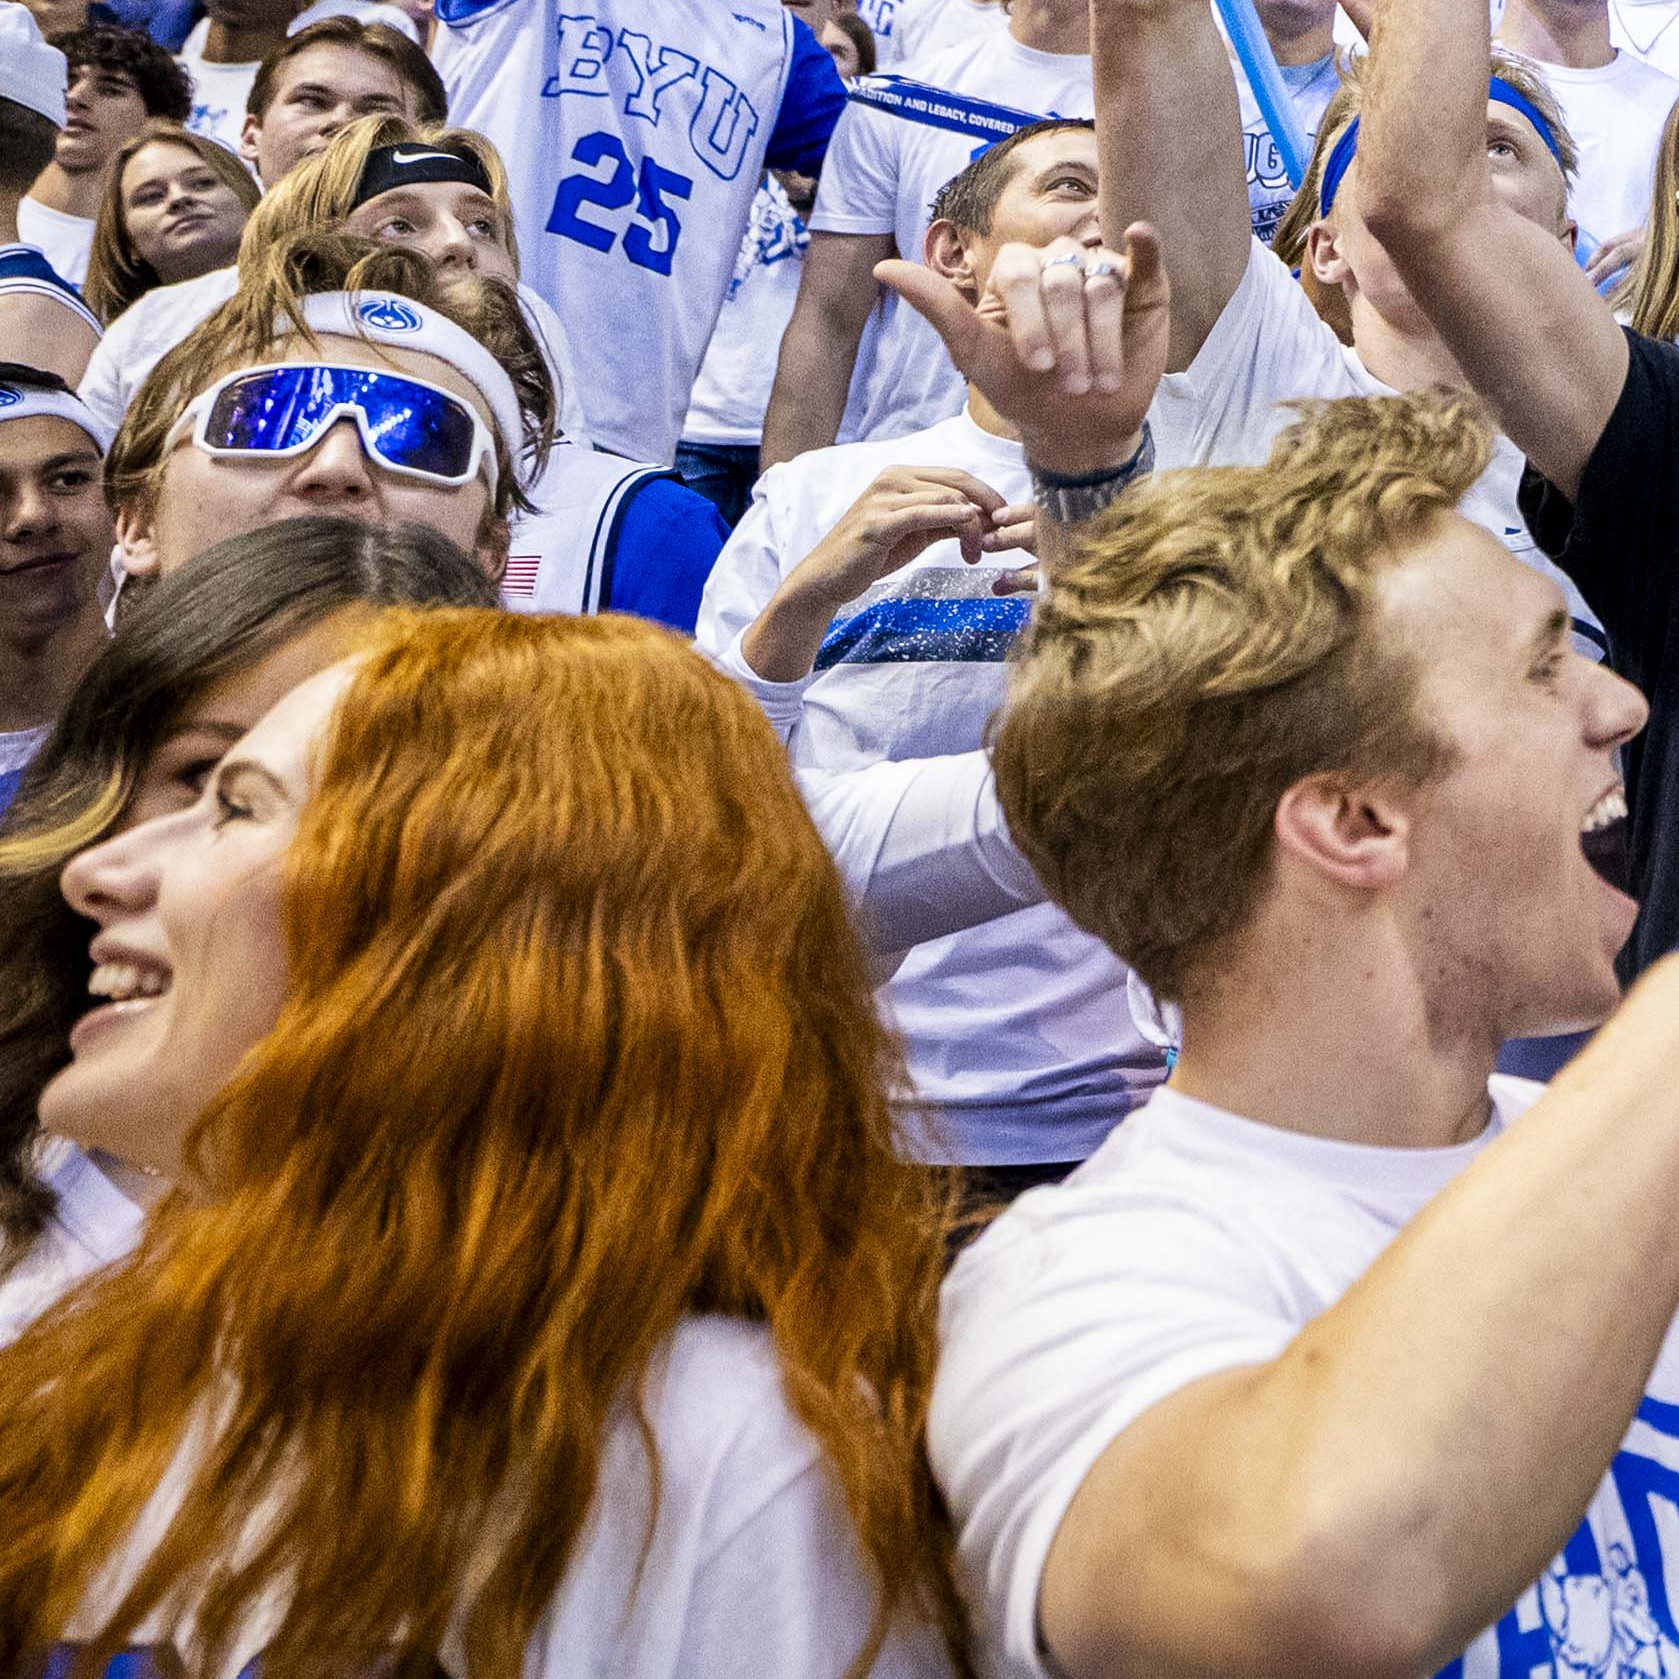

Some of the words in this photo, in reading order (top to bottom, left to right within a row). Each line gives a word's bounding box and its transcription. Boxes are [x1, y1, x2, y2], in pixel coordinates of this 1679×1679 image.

[540, 14, 758, 181] BYU
[968, 112, 1015, 135] COVERED
[545, 130, 694, 278] 25
